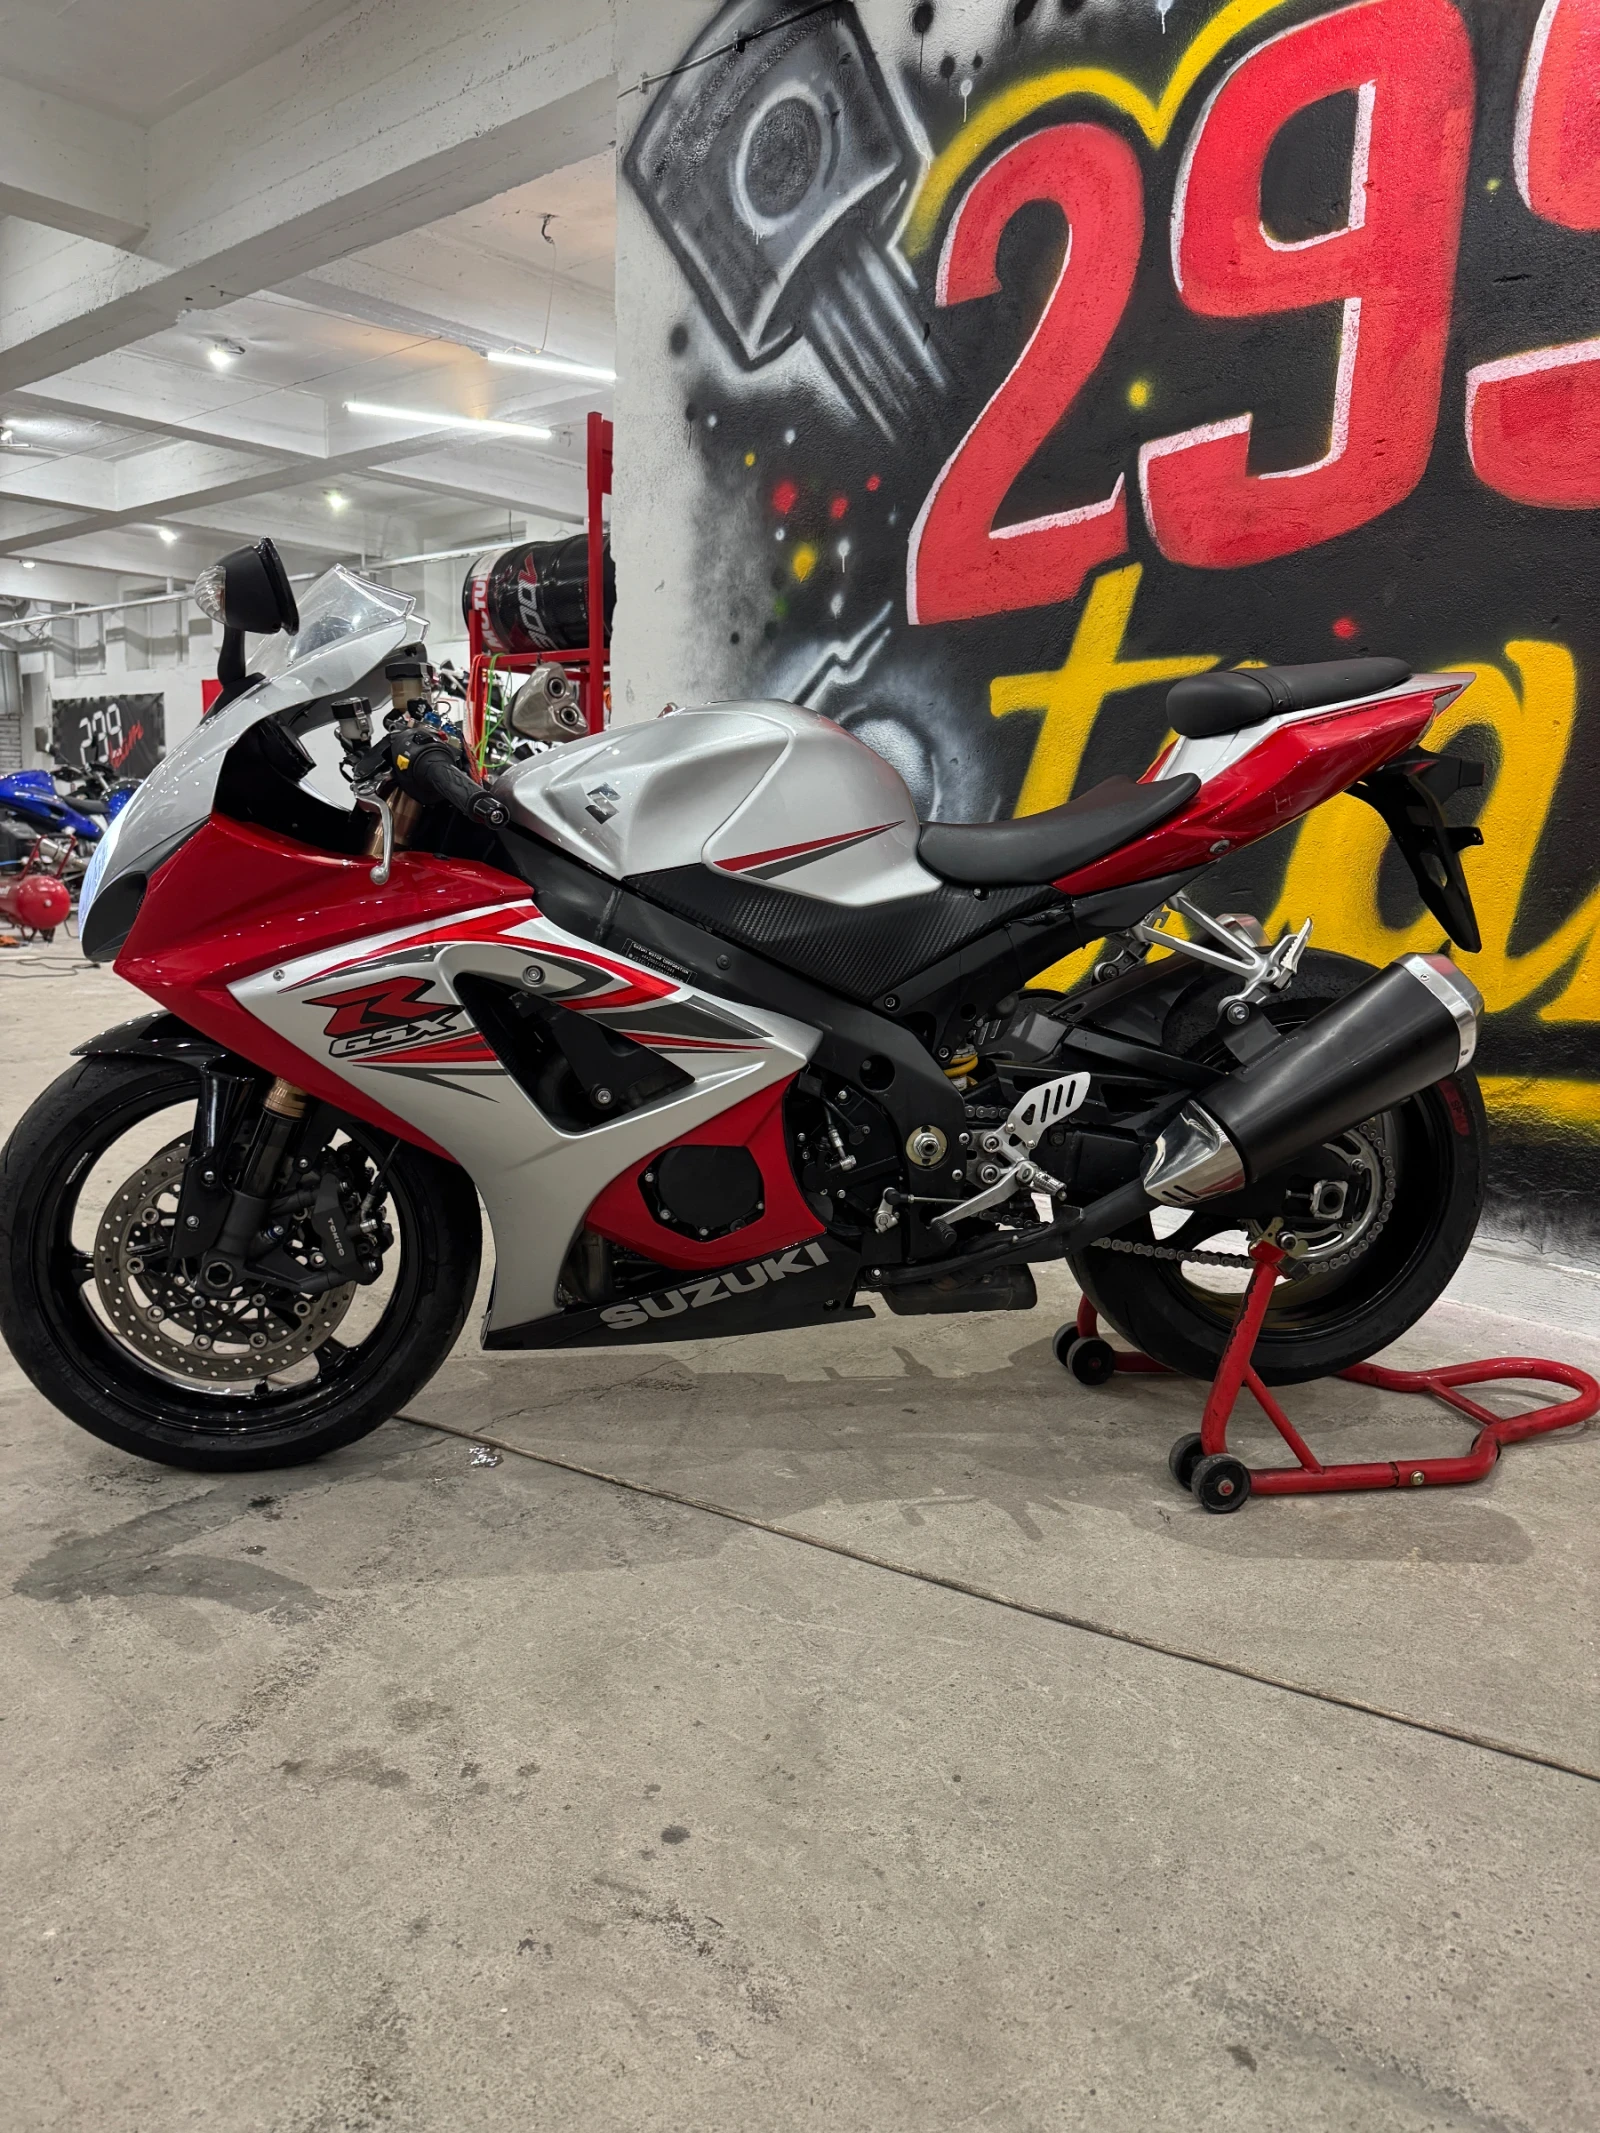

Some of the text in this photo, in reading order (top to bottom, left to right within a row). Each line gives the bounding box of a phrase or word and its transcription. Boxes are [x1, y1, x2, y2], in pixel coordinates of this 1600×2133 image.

[329, 1011, 457, 1058] GSX
[327, 1217, 345, 1257] TOKICO
[600, 1241, 830, 1330] SUZUKI
